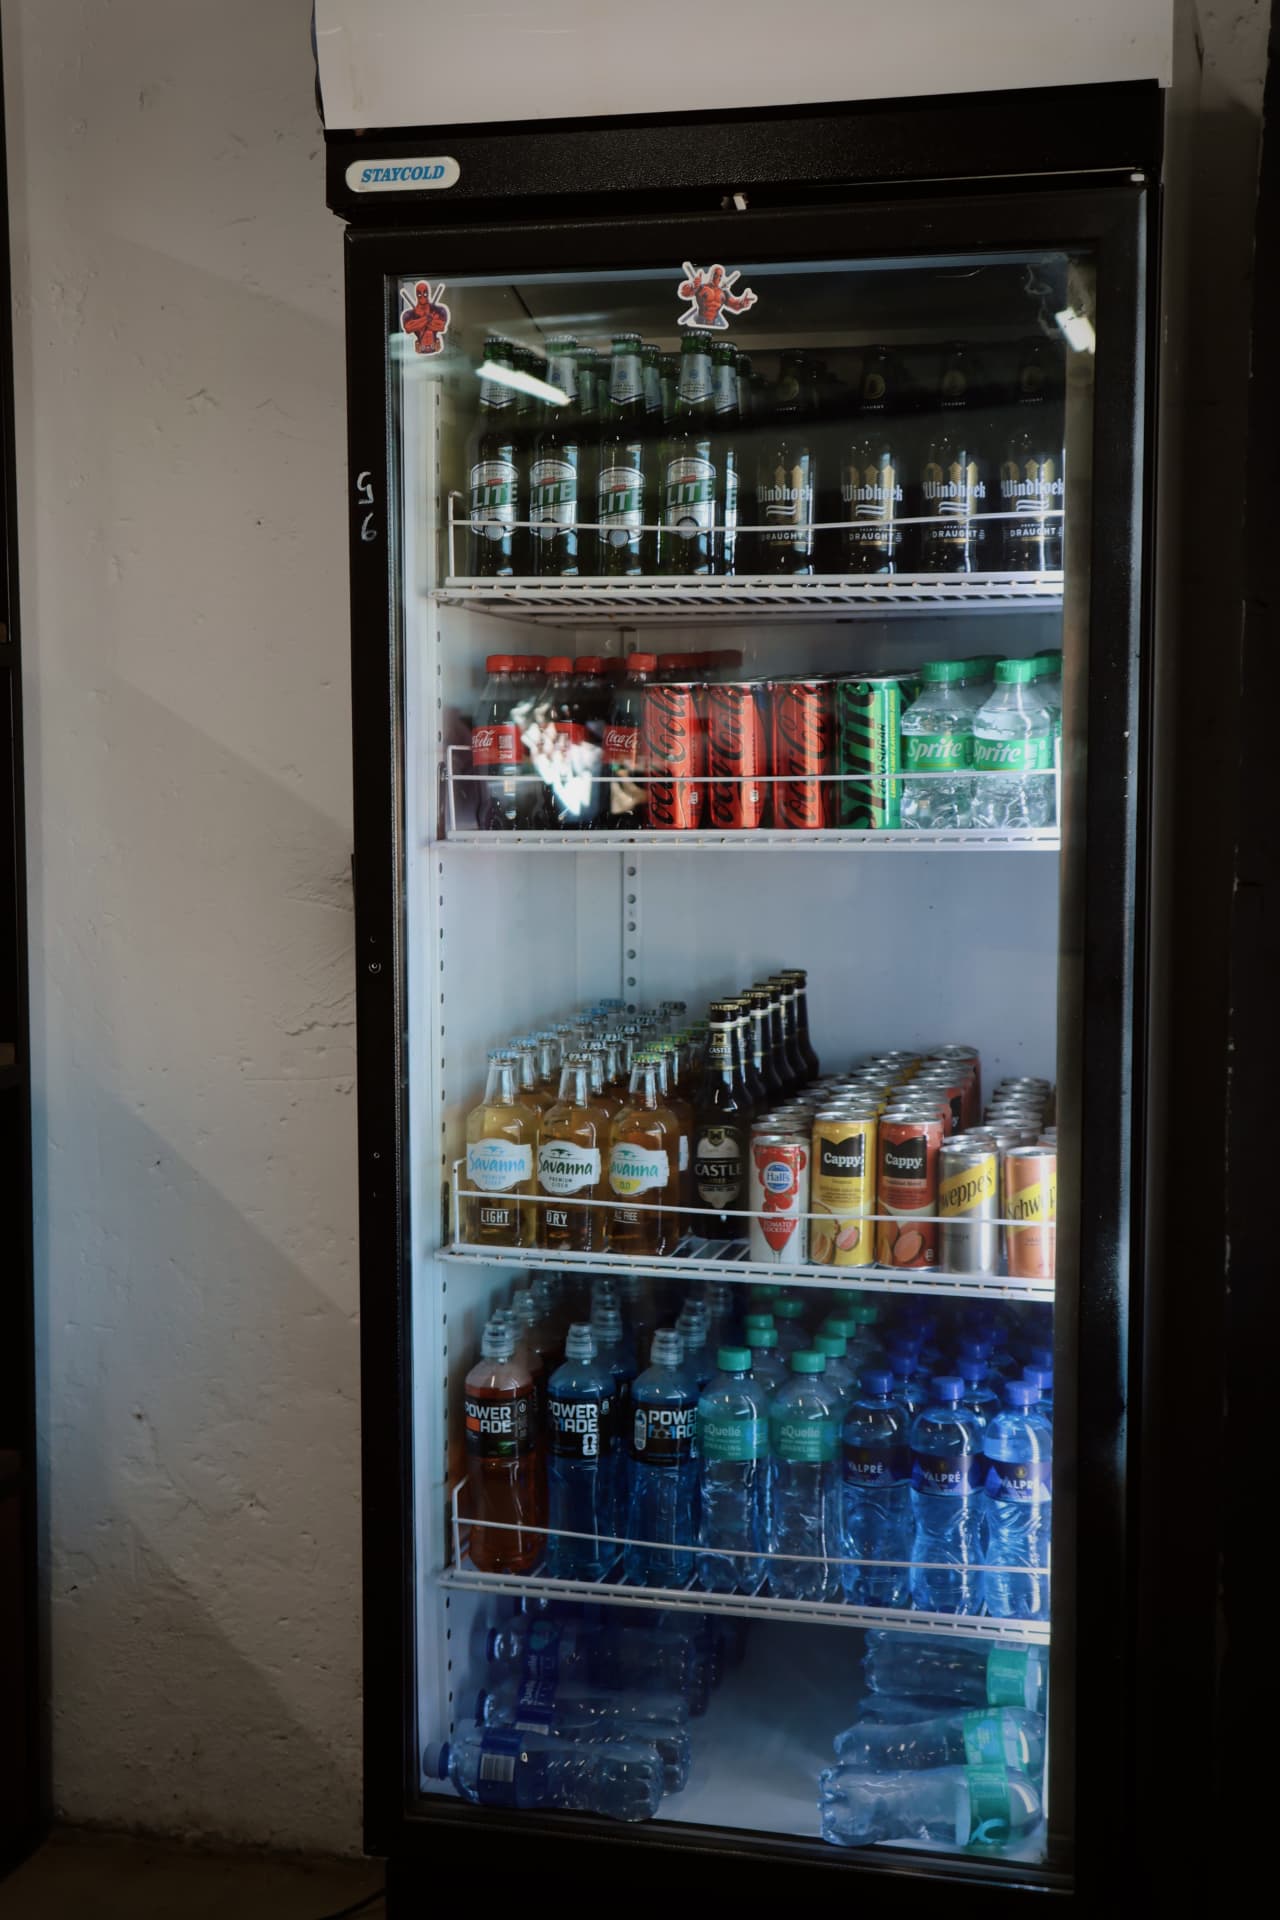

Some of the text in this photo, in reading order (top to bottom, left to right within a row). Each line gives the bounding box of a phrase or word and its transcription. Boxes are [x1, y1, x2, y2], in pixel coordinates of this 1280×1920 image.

[361, 165, 446, 184] STAYCOLD
[472, 482, 519, 509] LITE
[666, 479, 714, 506] LITE
[841, 483, 904, 502] Windhoek
[922, 479, 987, 499] Windhoek
[600, 485, 644, 515] LITE
[849, 532, 895, 542] DRAUGHT
[932, 529, 978, 539] DRAUGHT
[1010, 526, 1057, 538] DRAUGHT
[907, 737, 963, 762] Sprite
[468, 1148, 526, 1174] Savanna
[538, 1151, 594, 1176] Savanna
[610, 1160, 659, 1178] avanna
[695, 1162, 743, 1177] CASTLE
[480, 1209, 510, 1223] LIGHT
[546, 1212, 568, 1225] DRY
[464, 1400, 512, 1420] POWER
[548, 1399, 599, 1419] POWER
[923, 1471, 961, 1484] VALPRÉ
